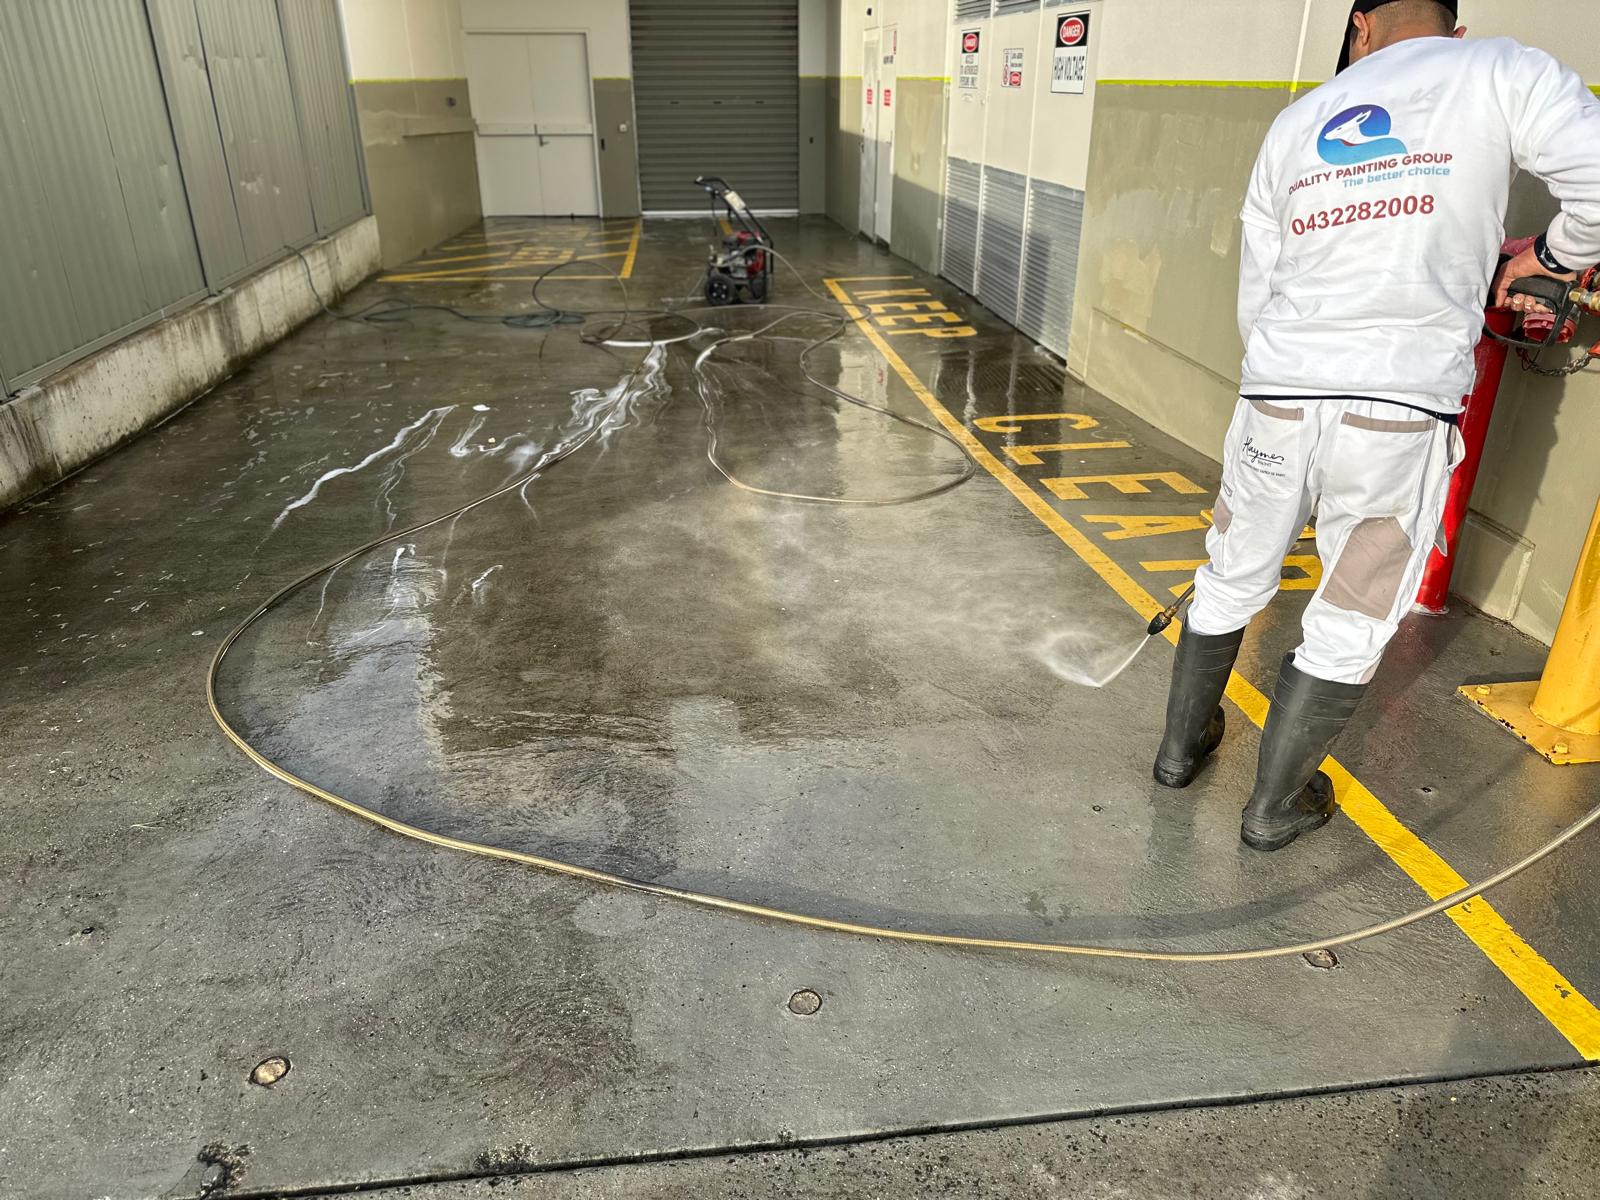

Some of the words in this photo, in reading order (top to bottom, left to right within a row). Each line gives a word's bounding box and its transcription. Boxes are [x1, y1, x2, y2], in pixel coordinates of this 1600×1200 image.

[1062, 24, 1081, 38] DANGER
[1288, 171, 1332, 195] QUALITY
[1336, 158, 1398, 179] PAINTING
[1402, 152, 1453, 166] GROUP
[1342, 178, 1364, 188] The
[1367, 169, 1404, 185] better
[1407, 165, 1451, 177] choice
[1291, 194, 1435, 236] 0432282008
[852, 288, 978, 338] KEEP
[1242, 436, 1285, 463] Haymes
